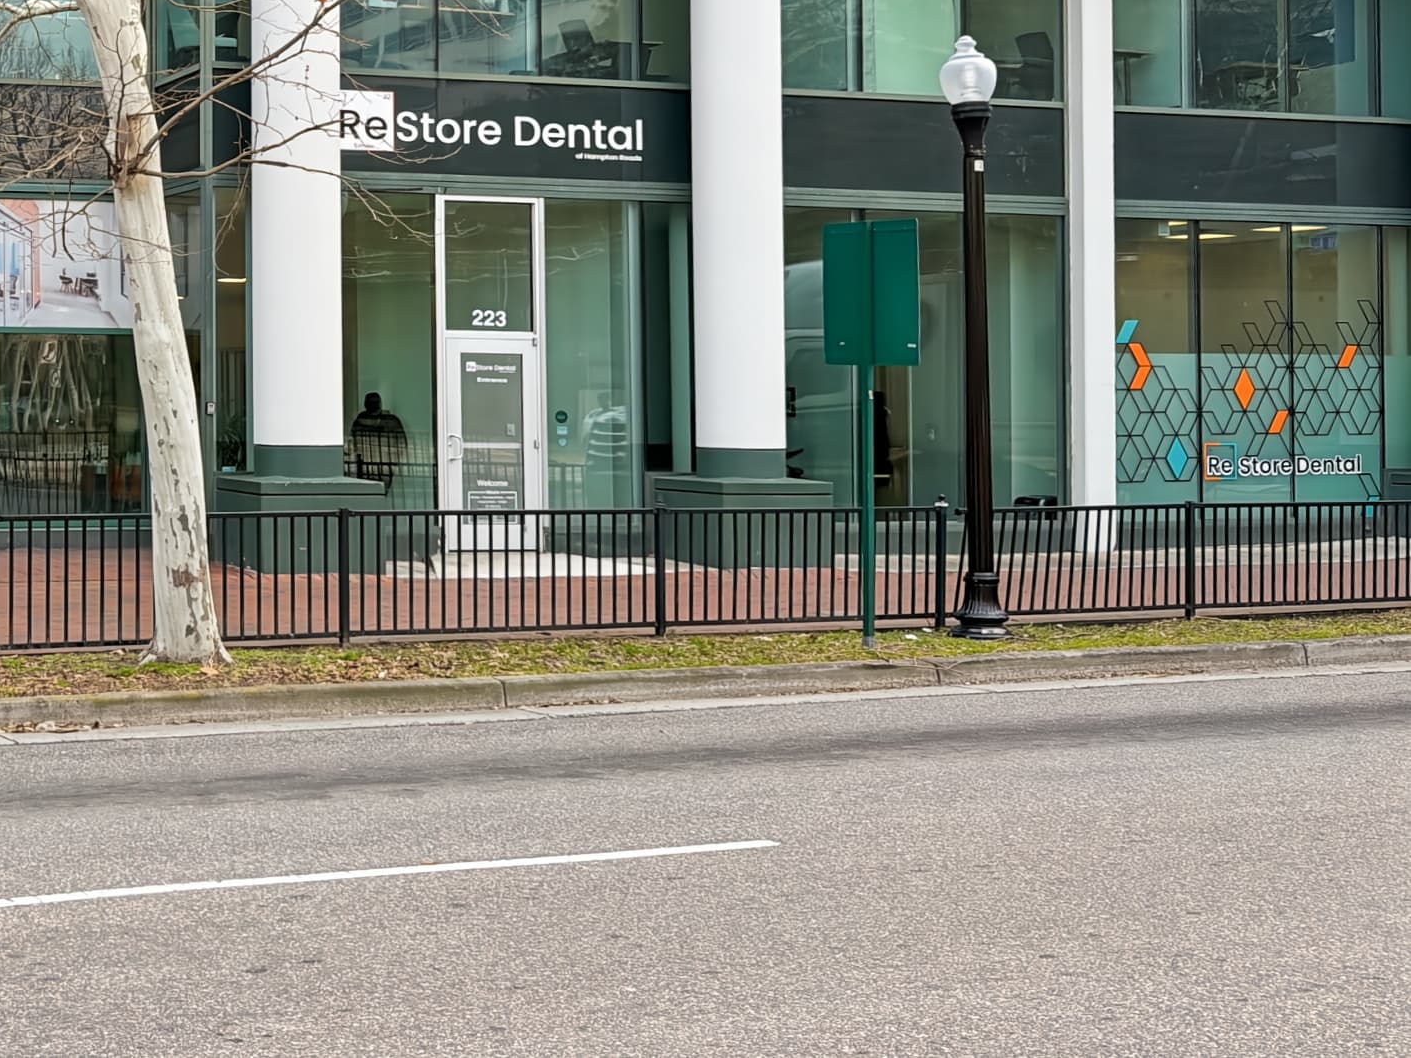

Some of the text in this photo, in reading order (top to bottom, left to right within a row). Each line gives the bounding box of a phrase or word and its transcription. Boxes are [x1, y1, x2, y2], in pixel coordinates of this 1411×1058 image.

[514, 115, 643, 151] Dental
[471, 309, 507, 327] 223
[1207, 455, 1233, 475] Re
[1295, 454, 1362, 474] Dental
